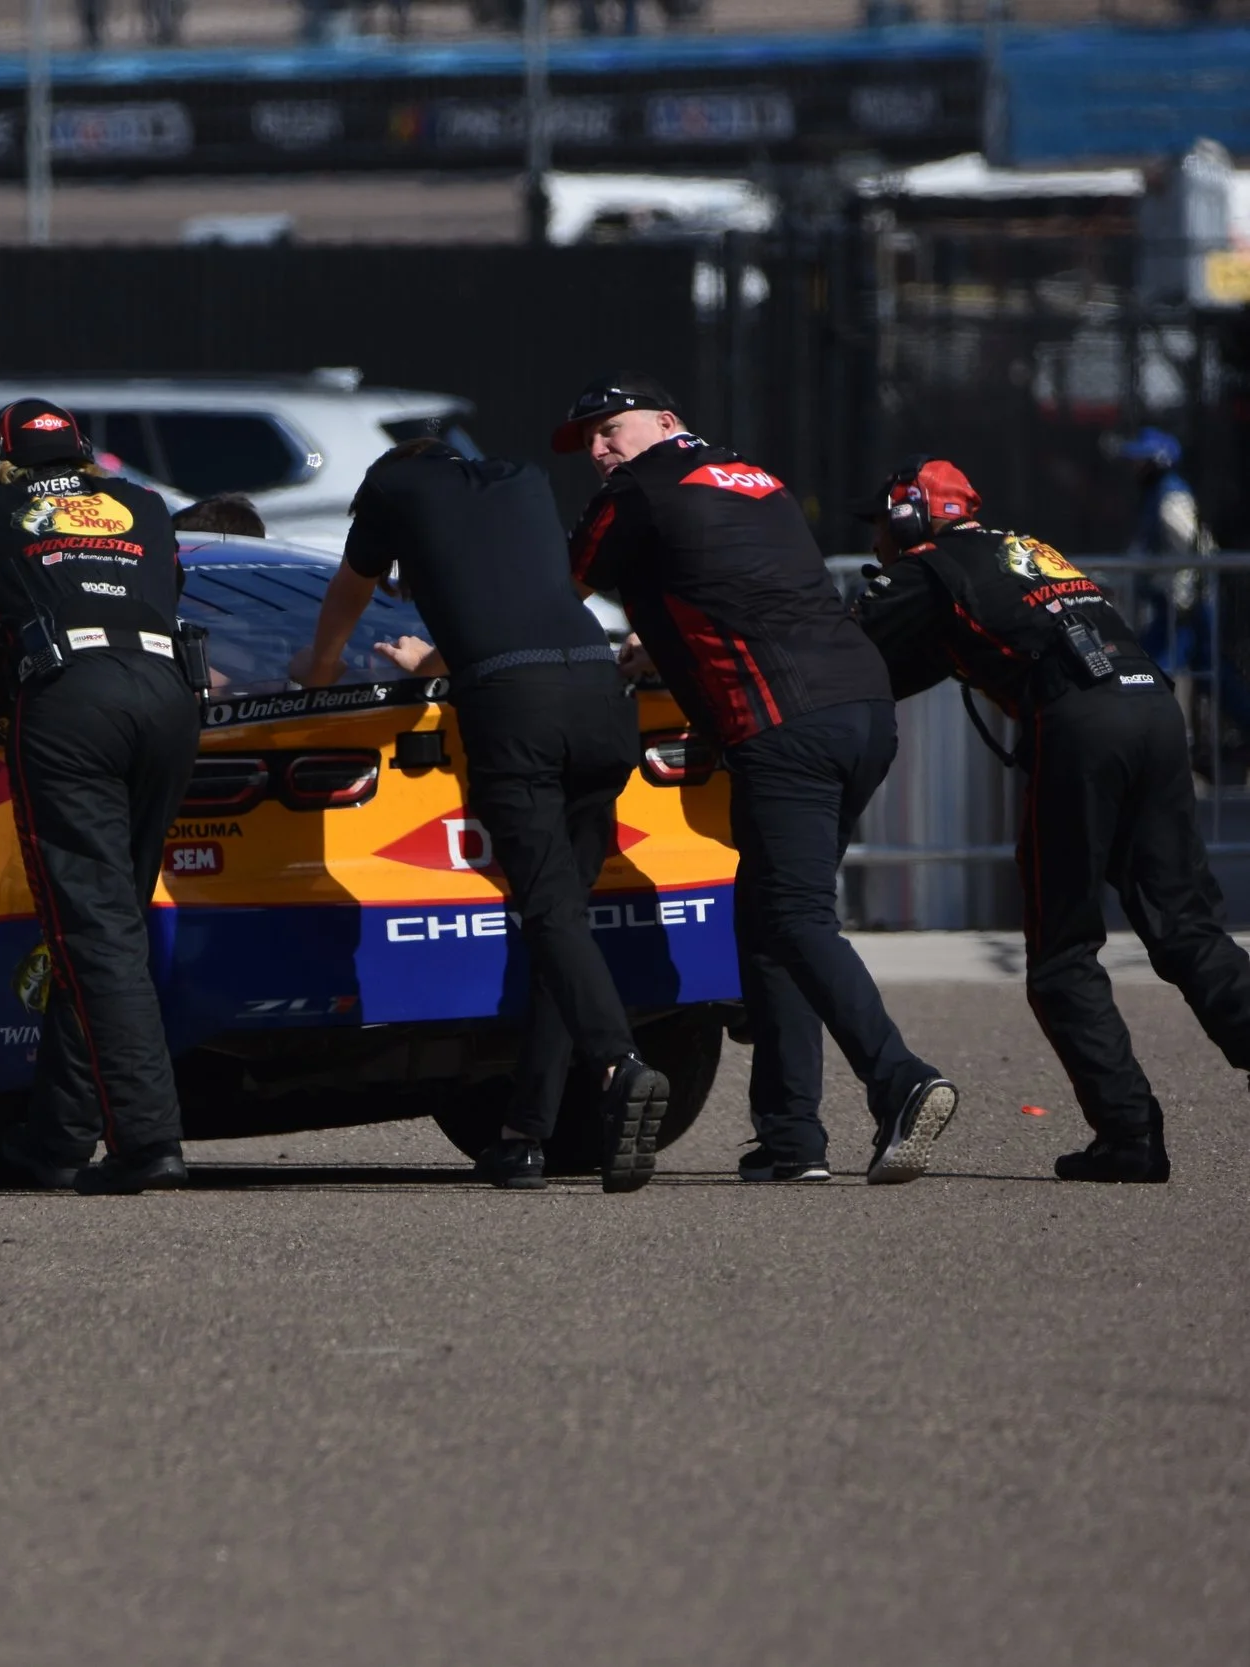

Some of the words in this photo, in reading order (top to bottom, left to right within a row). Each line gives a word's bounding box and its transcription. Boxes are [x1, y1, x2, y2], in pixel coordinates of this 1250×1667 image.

[27, 476, 81, 493] MYERS
[54, 496, 103, 508] Bass
[64, 506, 99, 516] Pro
[69, 515, 126, 532] Shops
[23, 536, 145, 558] WINCHESTER
[114, 555, 138, 566] Legend
[237, 695, 307, 720] United
[312, 684, 389, 708] Rentals
[166, 822, 244, 839] OKUMA
[172, 847, 216, 870] SEM
